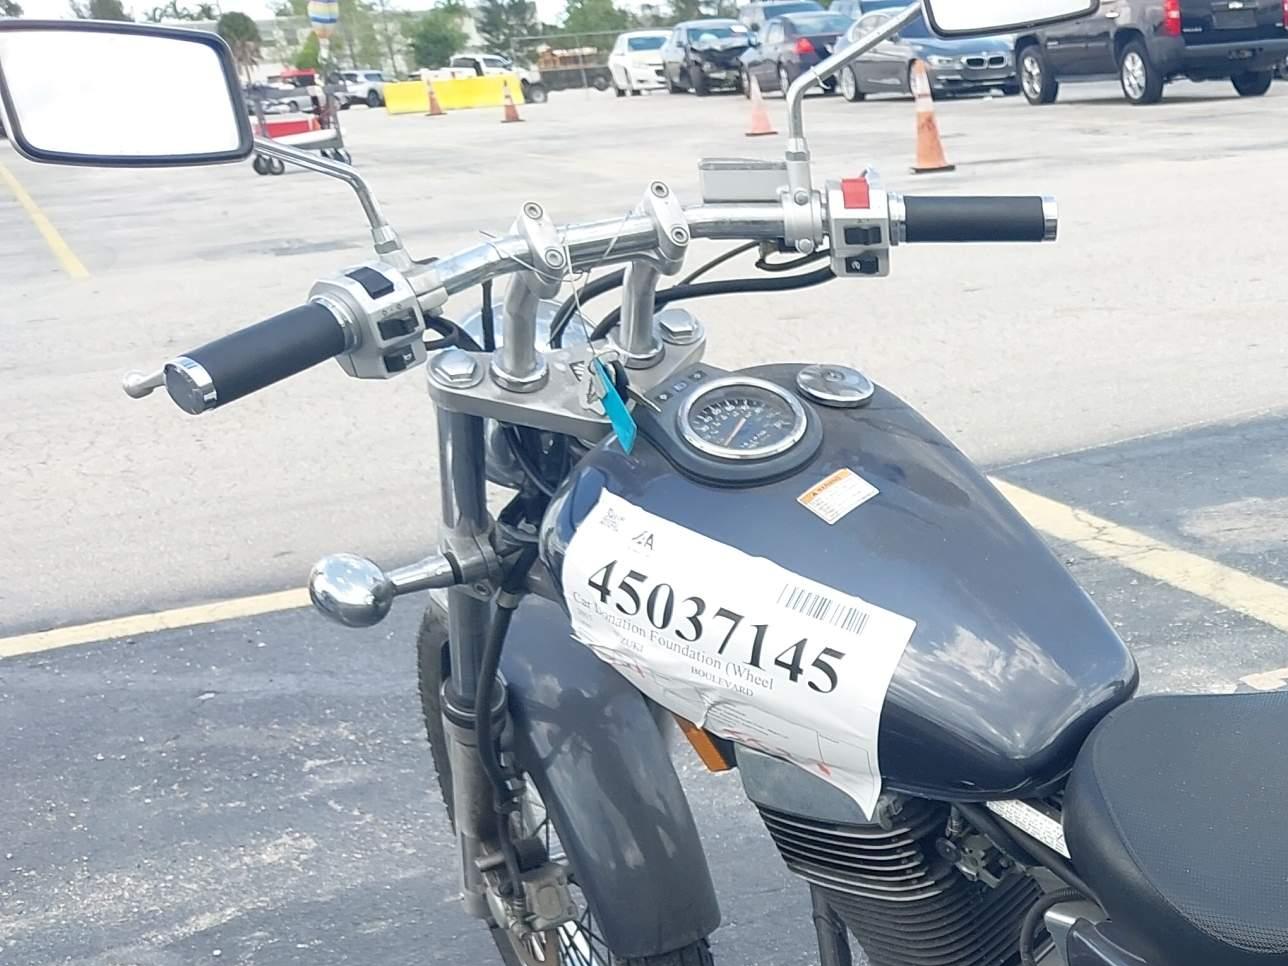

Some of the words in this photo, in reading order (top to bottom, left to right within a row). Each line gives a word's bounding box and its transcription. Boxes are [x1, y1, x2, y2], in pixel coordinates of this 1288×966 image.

[587, 559, 847, 694] 45037145
[649, 628, 722, 670] Foundation
[725, 661, 774, 691] (Wheel
[690, 665, 755, 697] BOULEVARD
